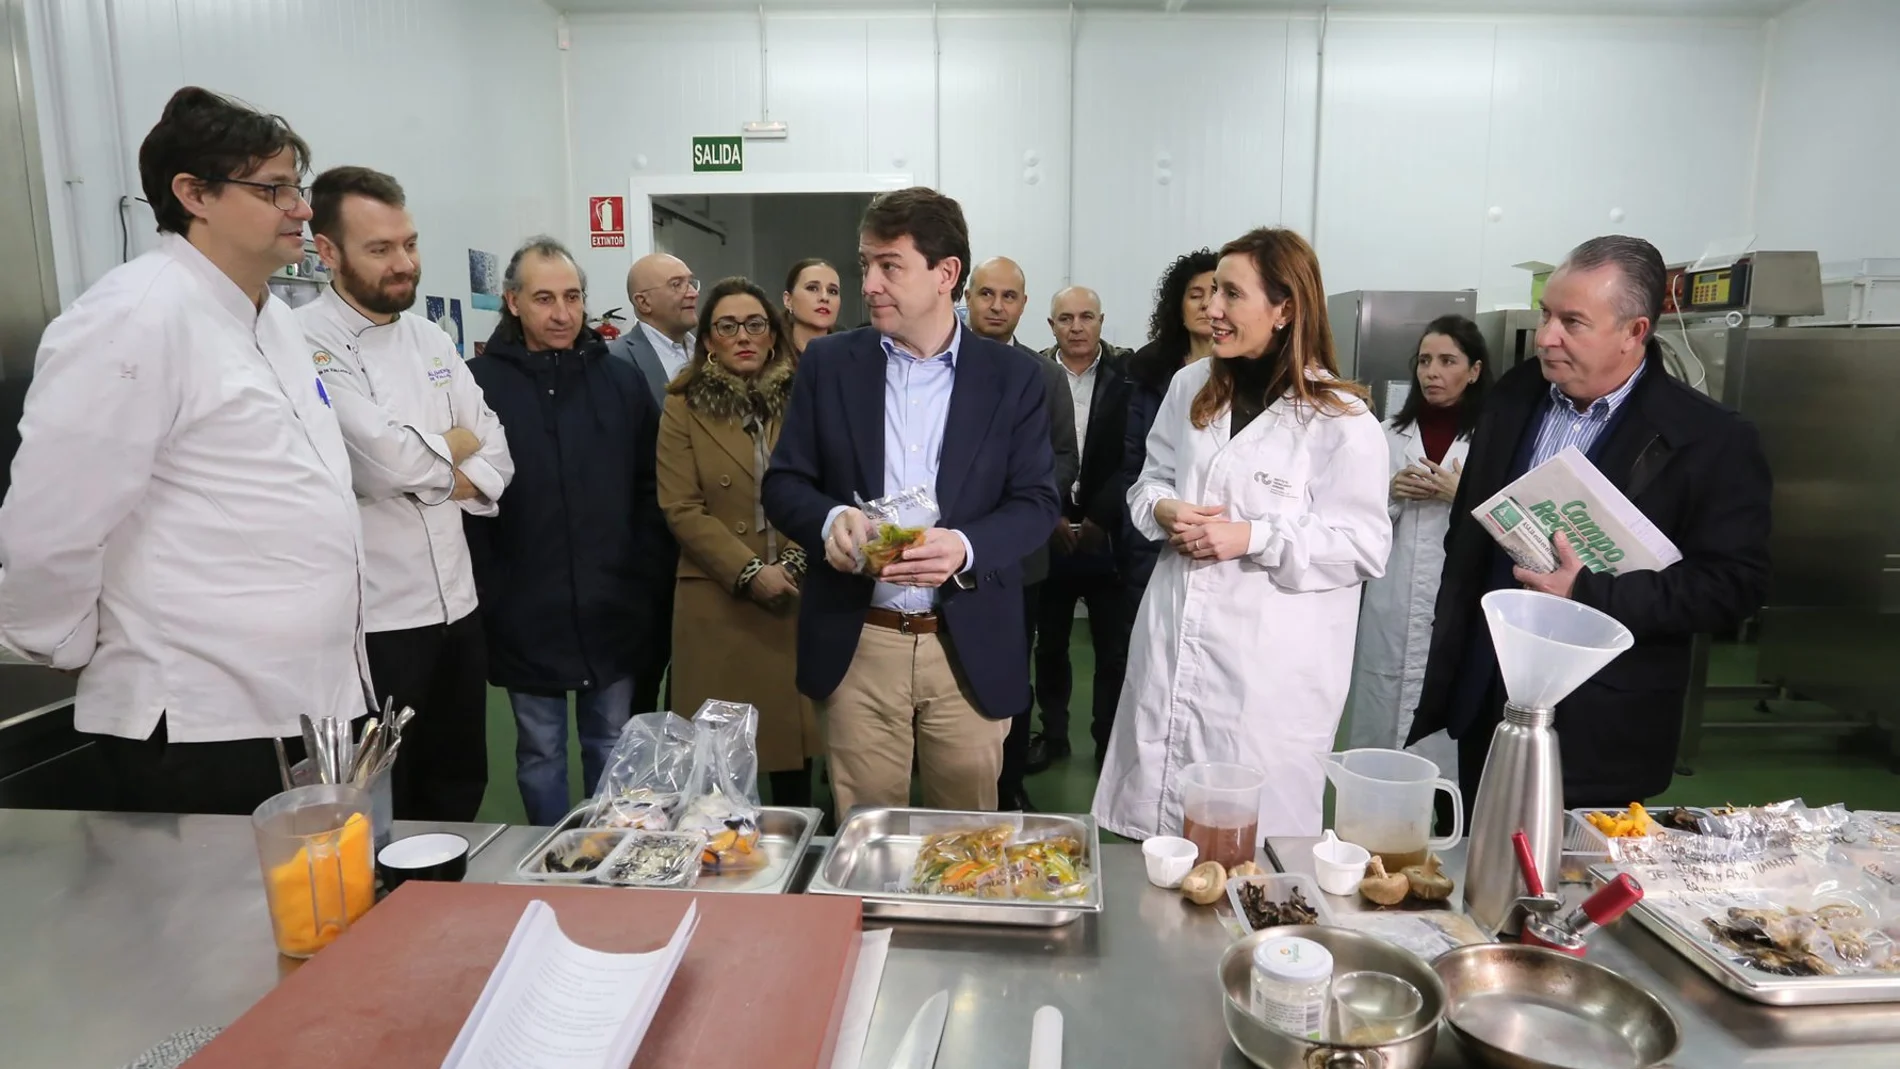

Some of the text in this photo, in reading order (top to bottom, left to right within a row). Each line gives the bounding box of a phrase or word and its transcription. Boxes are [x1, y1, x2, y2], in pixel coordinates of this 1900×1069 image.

[694, 143, 741, 165] SALIDA
[592, 235, 624, 246] EXTINTOR
[1561, 500, 1625, 563] Campo
